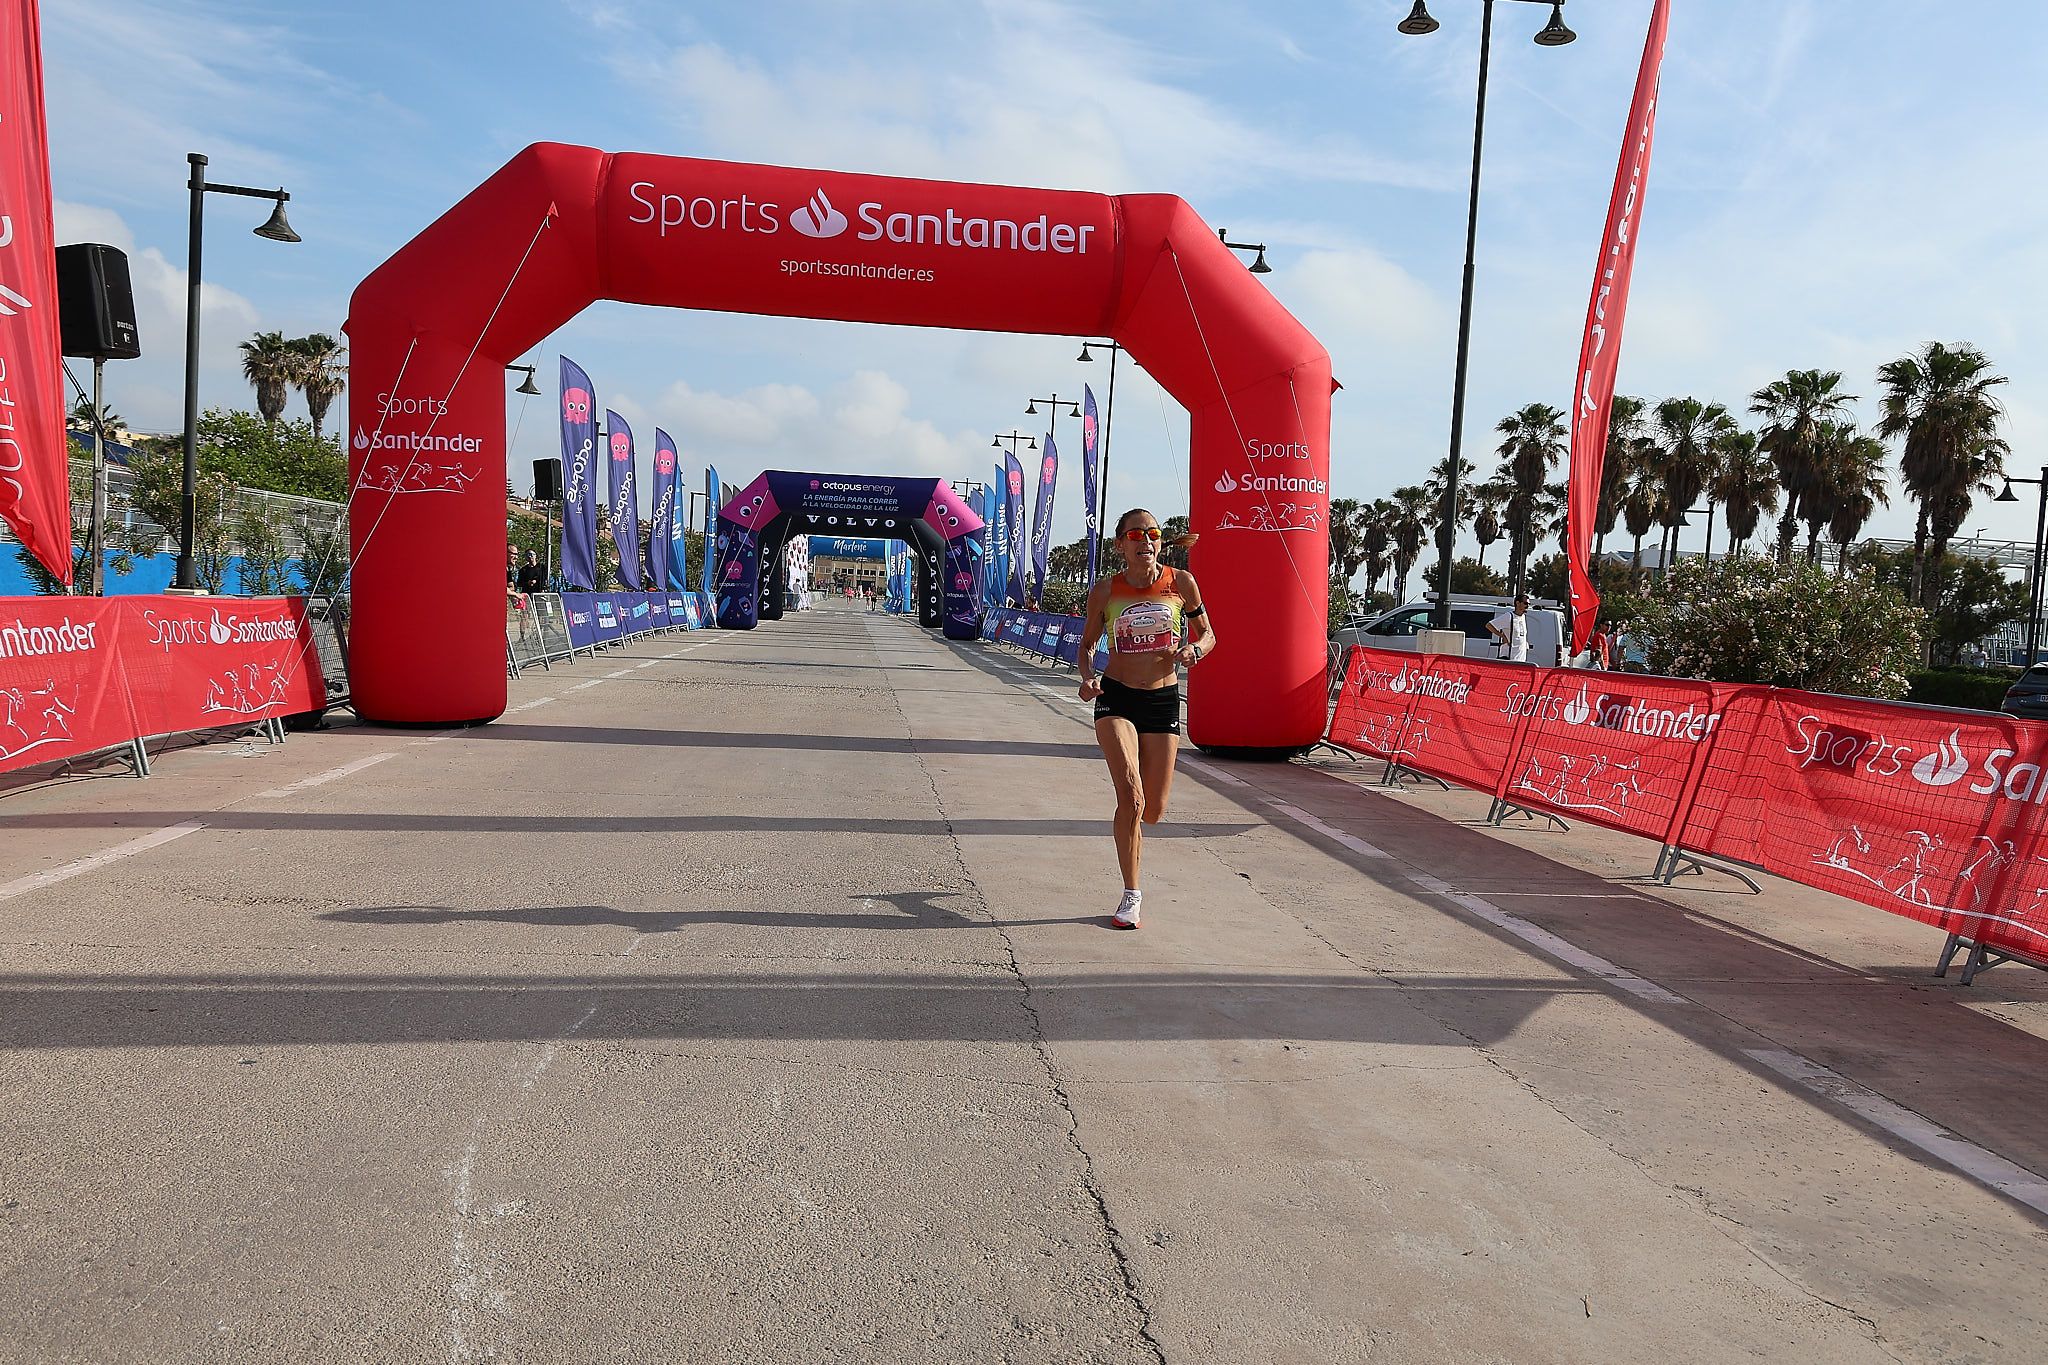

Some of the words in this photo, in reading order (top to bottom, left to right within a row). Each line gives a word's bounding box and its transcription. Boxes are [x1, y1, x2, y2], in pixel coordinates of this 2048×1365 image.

[629, 182, 779, 237] Sports
[857, 202, 1096, 255] Santander
[780, 258, 935, 283] sportssantander.es
[377, 392, 448, 418] Sports
[372, 430, 483, 453] Santander
[1247, 438, 1310, 462] Sports
[822, 482, 862, 493] octopus
[863, 484, 896, 496] energy
[1240, 473, 1327, 495] Santander
[814, 495, 846, 503] ENERGÍA
[847, 496, 867, 504] PARA
[806, 514, 896, 528] VOLVO
[144, 610, 207, 652] Sports
[228, 614, 298, 643] Santander
[1133, 634, 1156, 644] 016
[1405, 669, 1473, 705] Santander
[1500, 682, 1563, 724] Sports
[1590, 693, 1721, 741] Santander
[1786, 715, 1911, 776] Sports
